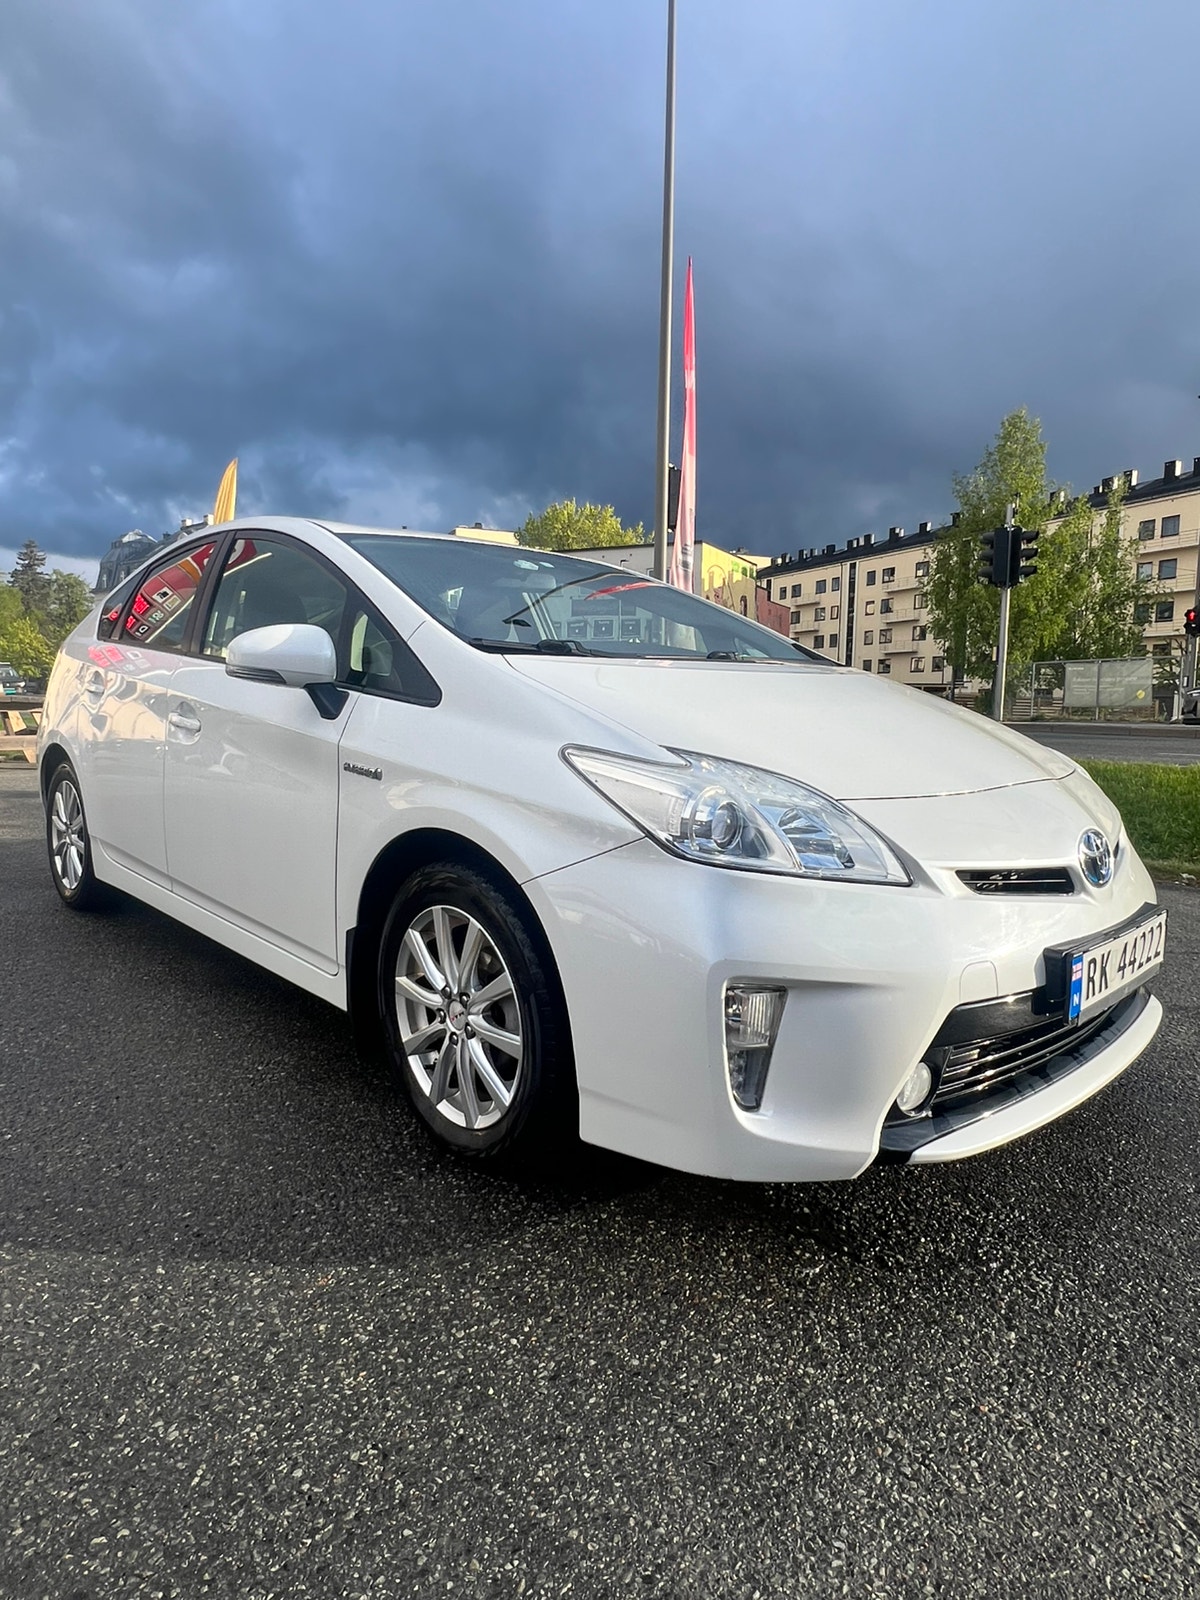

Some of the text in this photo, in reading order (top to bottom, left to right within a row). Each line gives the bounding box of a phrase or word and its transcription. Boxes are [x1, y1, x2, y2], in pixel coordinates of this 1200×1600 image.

[1085, 921, 1163, 1001] RK 44222
[1073, 992, 1080, 1007] N
